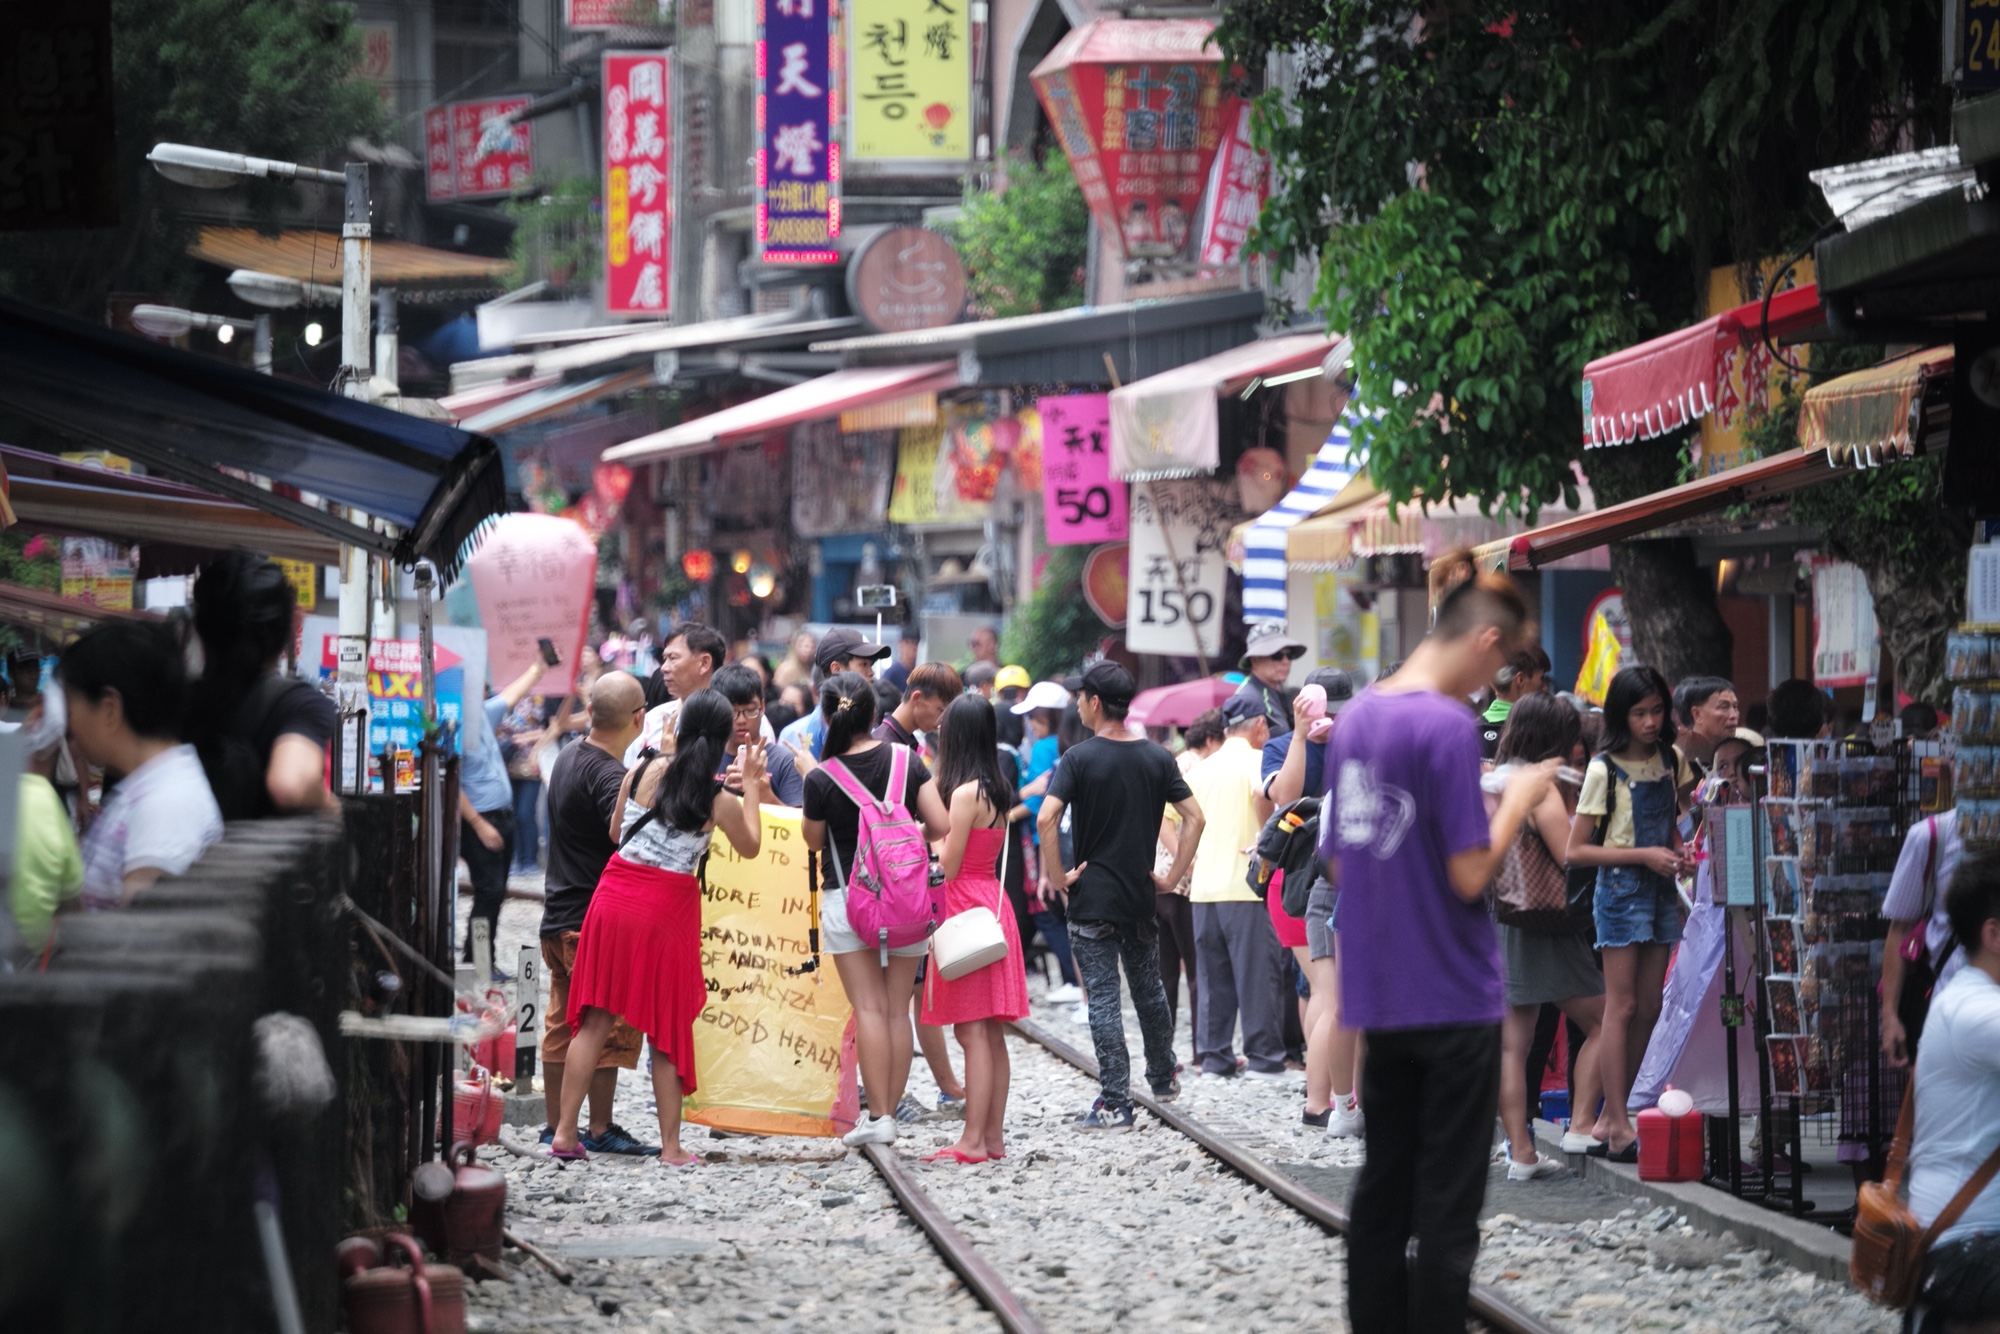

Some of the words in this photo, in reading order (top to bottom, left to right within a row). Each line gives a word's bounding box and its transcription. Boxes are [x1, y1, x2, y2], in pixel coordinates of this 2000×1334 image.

[862, 16, 917, 120] 천등
[1124, 65, 1199, 108] 十分
[1058, 487, 1110, 525] 50
[1139, 590, 1213, 626] 150
[373, 700, 460, 720] 猴硐、芳
[768, 825, 790, 840] TO
[768, 850, 790, 866] TO
[525, 961, 532, 980] 6
[701, 950, 725, 968] OF
[520, 1003, 535, 1033] 2
[702, 1006, 769, 1044] GOOD
